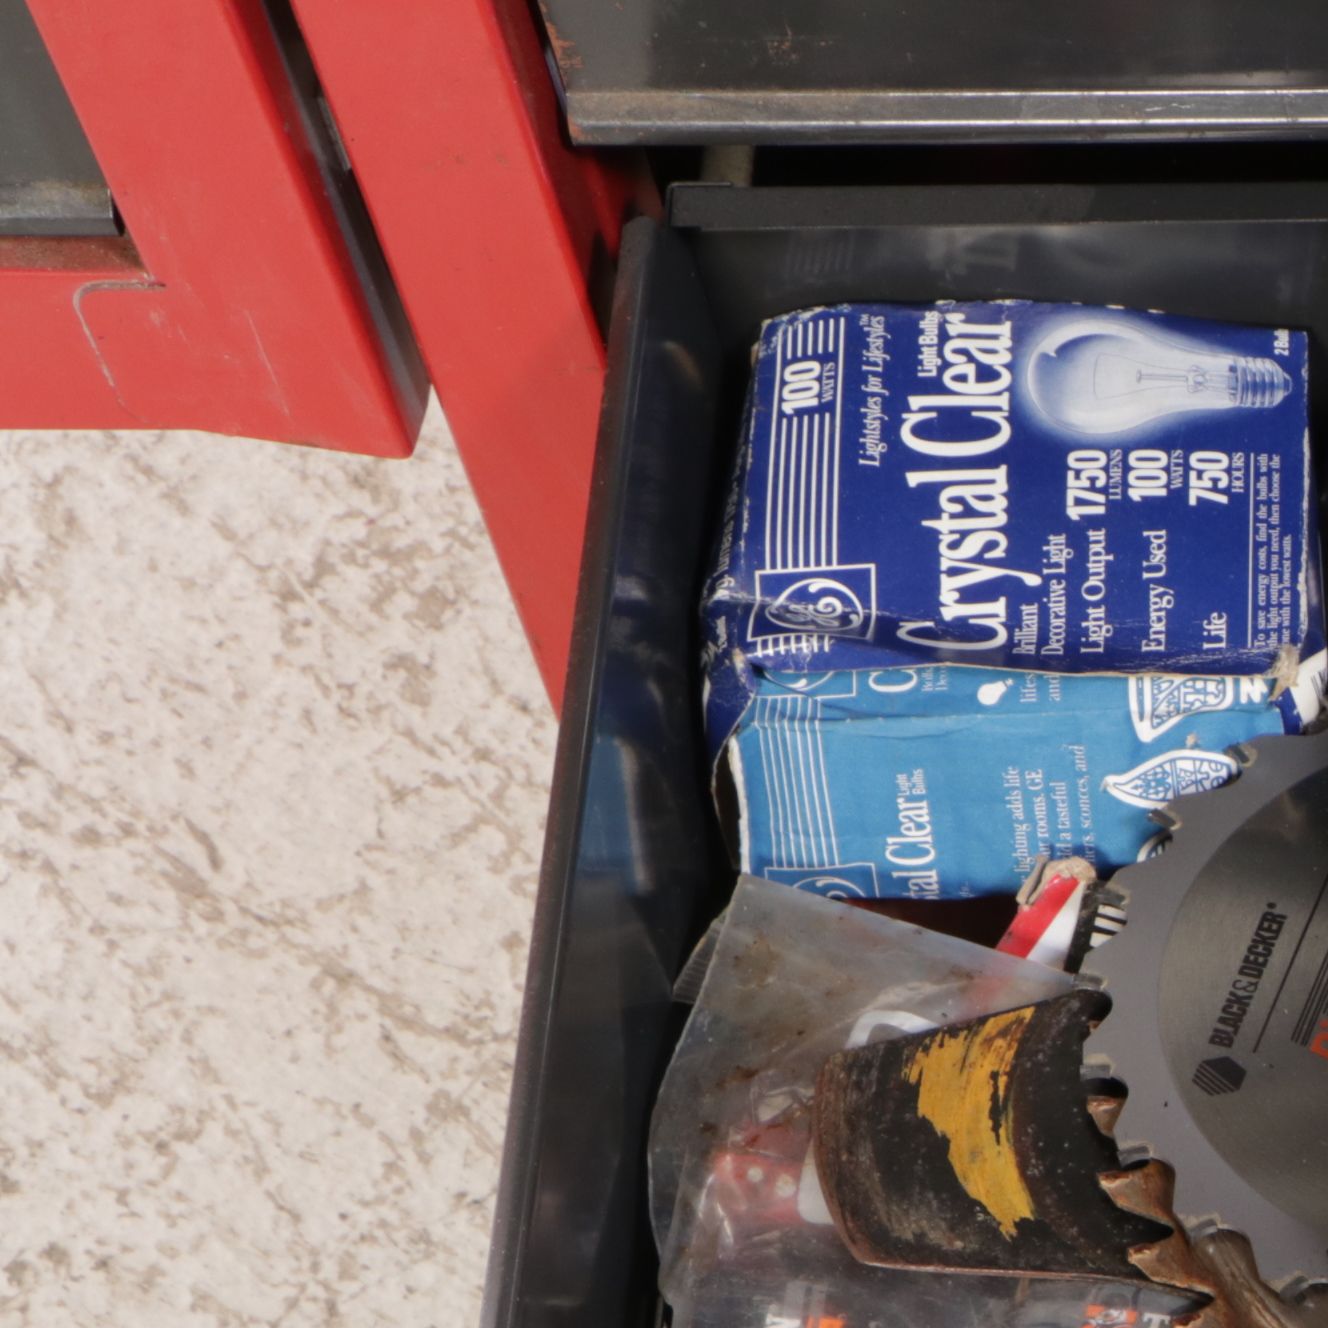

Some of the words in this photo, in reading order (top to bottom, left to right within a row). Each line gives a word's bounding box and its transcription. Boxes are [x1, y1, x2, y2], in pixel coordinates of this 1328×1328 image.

[918, 311, 943, 343] Bulbs
[917, 344, 942, 377] Light
[781, 361, 821, 415] 100
[821, 362, 836, 403] WATTS
[861, 372, 889, 395] for
[900, 312, 1013, 457] Clear
[858, 394, 888, 467] Lightstyles
[1109, 448, 1123, 501] LUMENS
[1127, 449, 1169, 502] 100
[1170, 449, 1184, 489] WATTS
[1231, 452, 1245, 493] HOURS
[1257, 453, 1268, 473] with
[1269, 454, 1281, 469] the
[1066, 449, 1108, 521] 1750
[1188, 450, 1230, 506] 750
[1256, 476, 1268, 500] bulbs
[1269, 471, 1281, 502] choose
[1256, 504, 1268, 520] the
[1269, 504, 1281, 525] then
[1256, 523, 1268, 541] find
[1269, 527, 1281, 552] need,
[1281, 534, 1293, 558] watts.
[896, 464, 1042, 650] Crystal
[1043, 533, 1074, 575] Light
[1081, 528, 1114, 601] Output
[1142, 529, 1168, 580] Used
[1257, 545, 1268, 570] costs,
[1270, 554, 1282, 572] you
[1258, 573, 1270, 606] energy
[1269, 573, 1283, 605] output
[1281, 559, 1292, 588] lowest
[1281, 589, 1292, 605] the
[1012, 603, 1039, 655] Brilliant
[1041, 578, 1066, 655] Decorative
[1080, 604, 1113, 653] Light
[1142, 583, 1174, 652] Energy
[1203, 611, 1228, 650] Life
[1258, 610, 1267, 630] save
[1267, 607, 1282, 629] light
[1281, 606, 1292, 627] with
[1254, 632, 1266, 648] To
[1268, 631, 1279, 649] the
[1020, 674, 1038, 703] lifes
[1069, 744, 1088, 771] and
[896, 773, 913, 797] Light
[911, 769, 927, 795] Bulbs
[1004, 766, 1021, 788] life
[1025, 769, 1044, 791] GE
[1004, 797, 1024, 823] adds
[1033, 793, 1050, 839] rooms.
[1050, 781, 1072, 829] tasteful
[1078, 775, 1095, 829] sconces,
[885, 797, 937, 866] Clear
[1014, 823, 1035, 872] lighting
